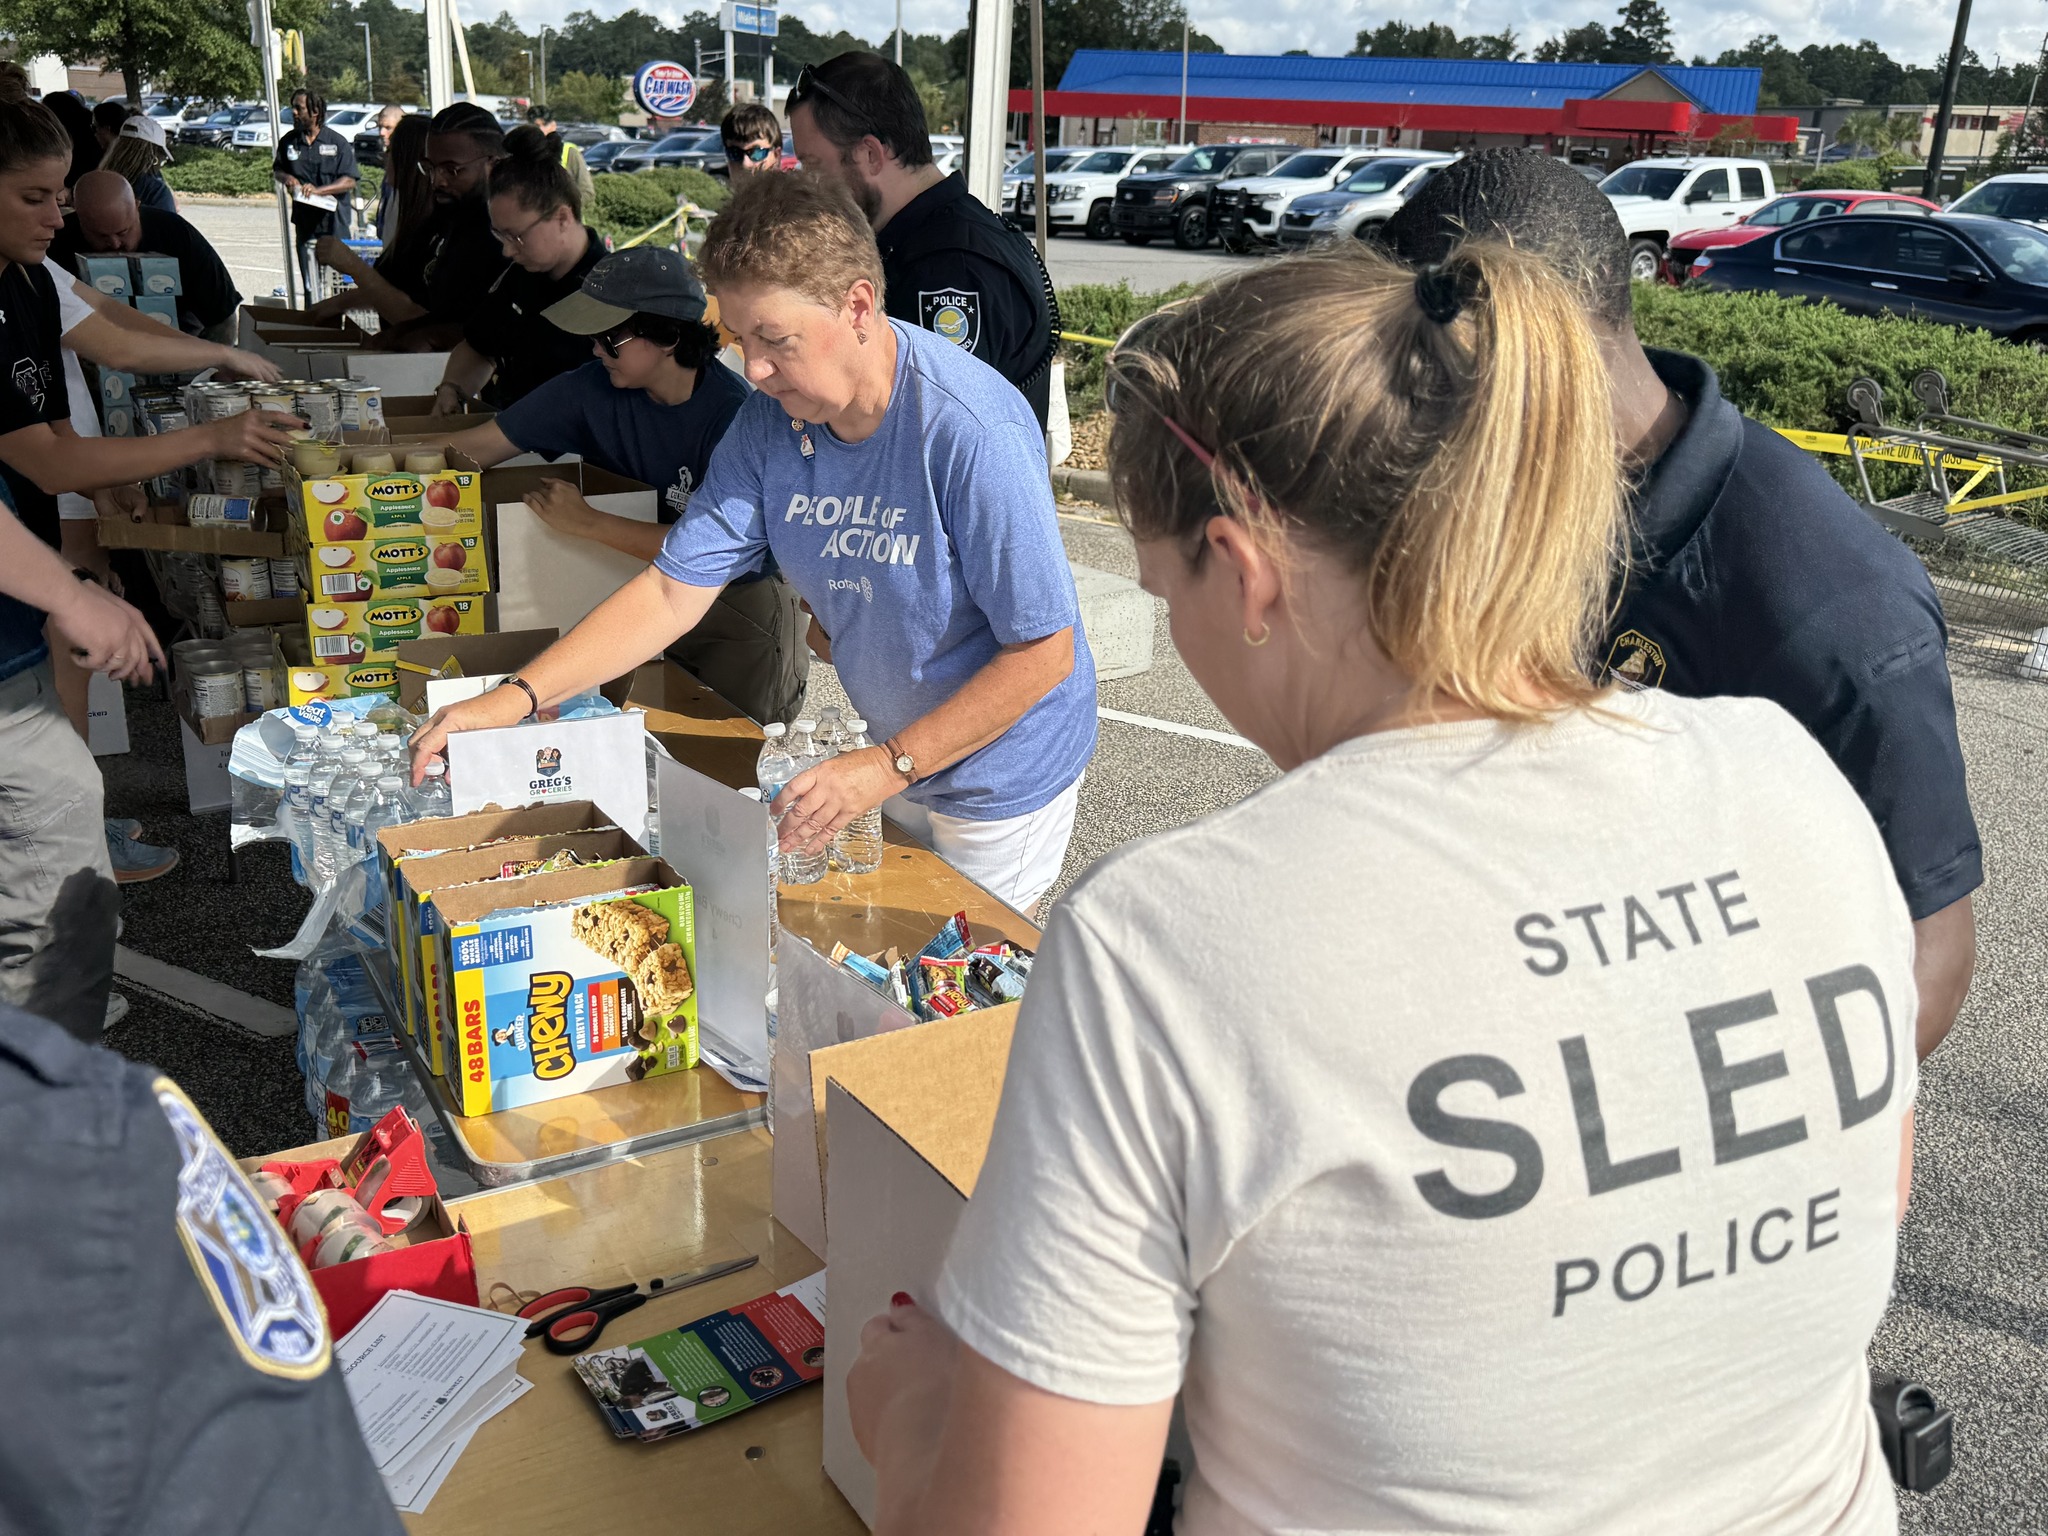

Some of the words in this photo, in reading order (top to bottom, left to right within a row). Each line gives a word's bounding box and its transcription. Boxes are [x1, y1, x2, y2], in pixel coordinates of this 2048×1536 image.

[644, 76, 665, 94] CAR
[666, 81, 692, 95] WASH
[933, 295, 968, 307] POLICE
[371, 484, 419, 496] MOTT'S
[458, 476, 470, 486] 18
[380, 504, 416, 512] Applesauce
[784, 493, 882, 526] PEOPLE
[881, 507, 907, 530] OF
[377, 547, 424, 559] MOTT'S
[464, 538, 476, 547] 18
[820, 528, 920, 566] ACTION
[370, 610, 417, 621] MOTT'S
[458, 602, 469, 610] 18
[1620, 636, 1663, 667] CHARLESTON
[351, 671, 398, 684] MOTT'S
[298, 710, 322, 724] Value
[529, 776, 572, 790] GREG'S
[1513, 869, 1760, 977] STATE
[461, 940, 470, 966] 100%
[574, 992, 584, 1015] PACK
[464, 999, 483, 1056] BARS
[514, 1013, 526, 1052] QUAKER
[575, 1016, 586, 1050] VARIETY
[469, 1056, 484, 1082] 48
[1406, 963, 1895, 1220] SLED
[327, 1106, 349, 1131] 40
[1552, 1188, 1841, 1317] POLICE
[370, 1334, 386, 1348] LIST
